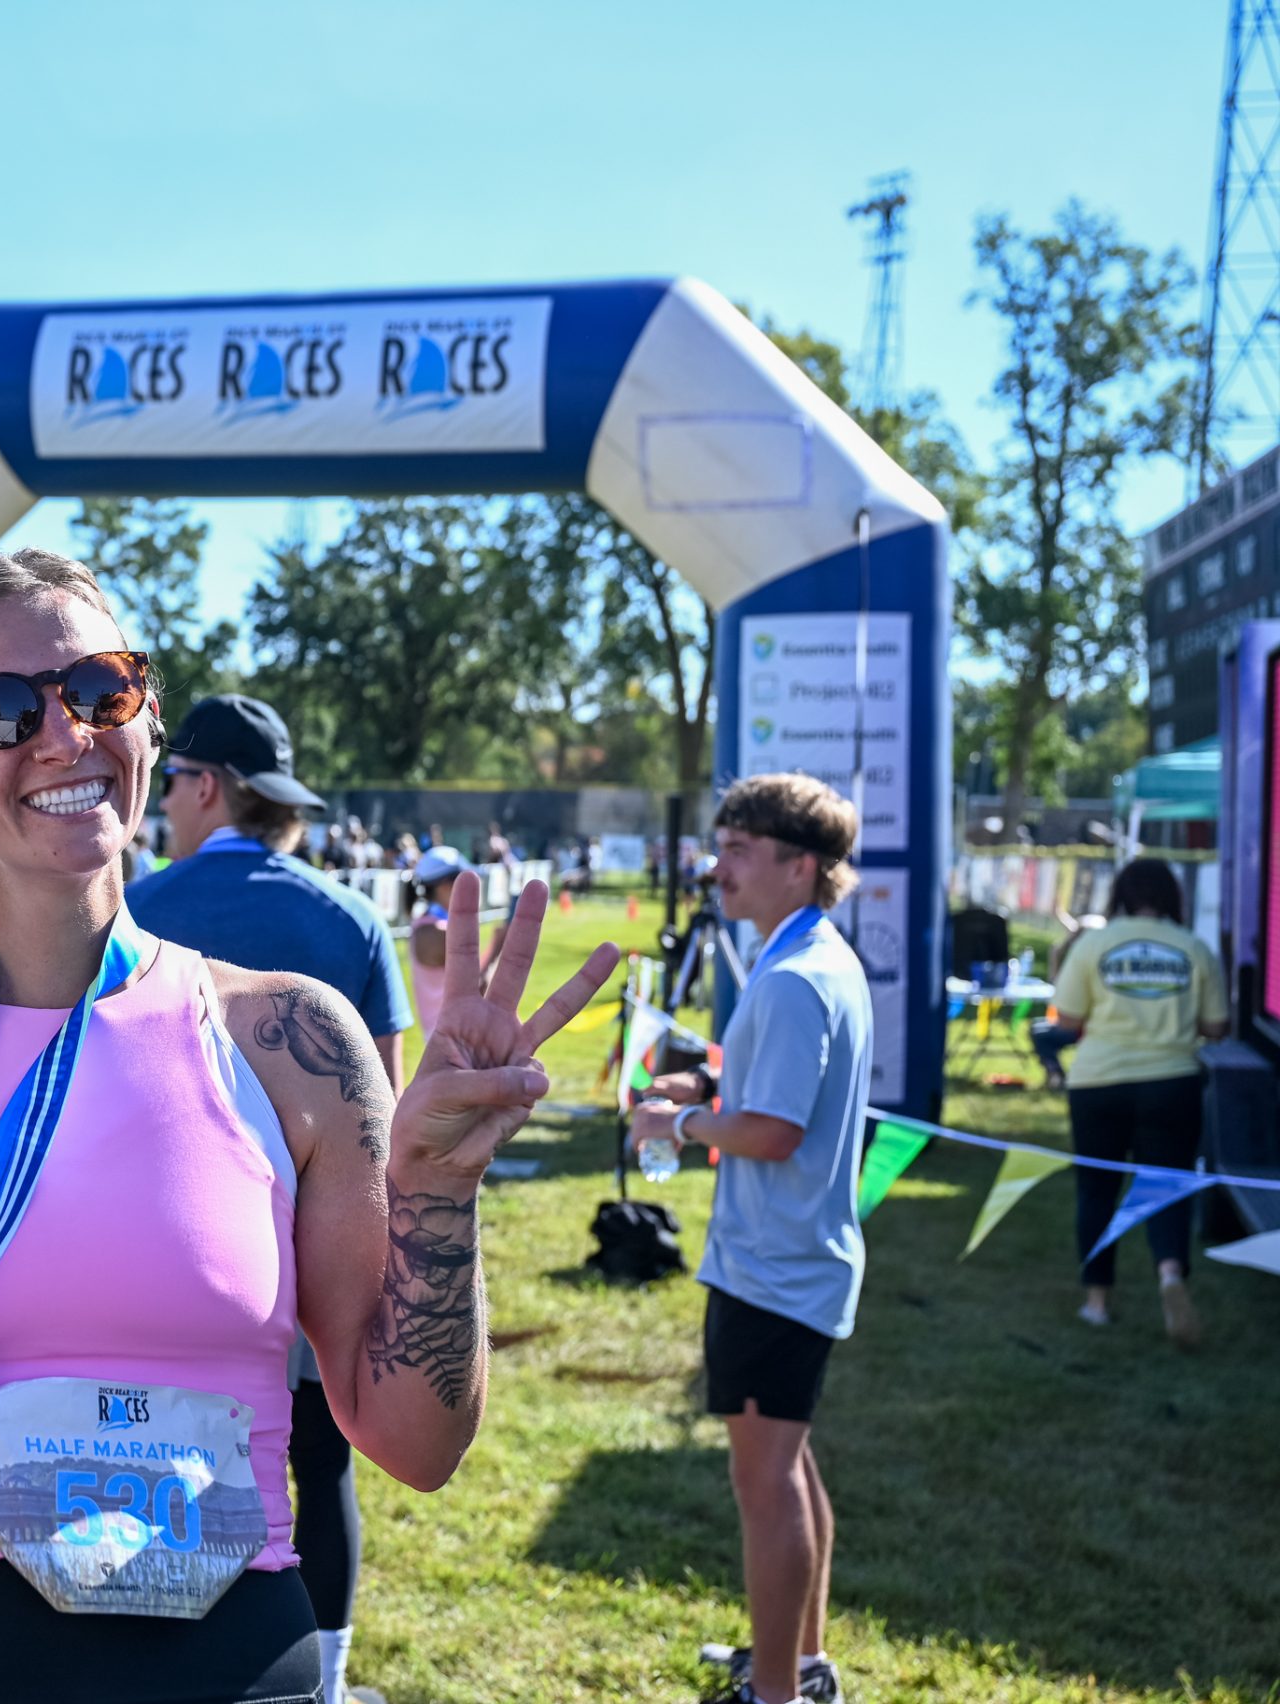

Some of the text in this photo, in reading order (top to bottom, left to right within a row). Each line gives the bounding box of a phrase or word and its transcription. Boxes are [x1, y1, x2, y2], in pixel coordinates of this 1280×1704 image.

[98, 1394, 150, 1423] RACES
[25, 1436, 216, 1468] HALF MARATHON
[56, 1469, 202, 1553] 530
[114, 1583, 142, 1592] Health
